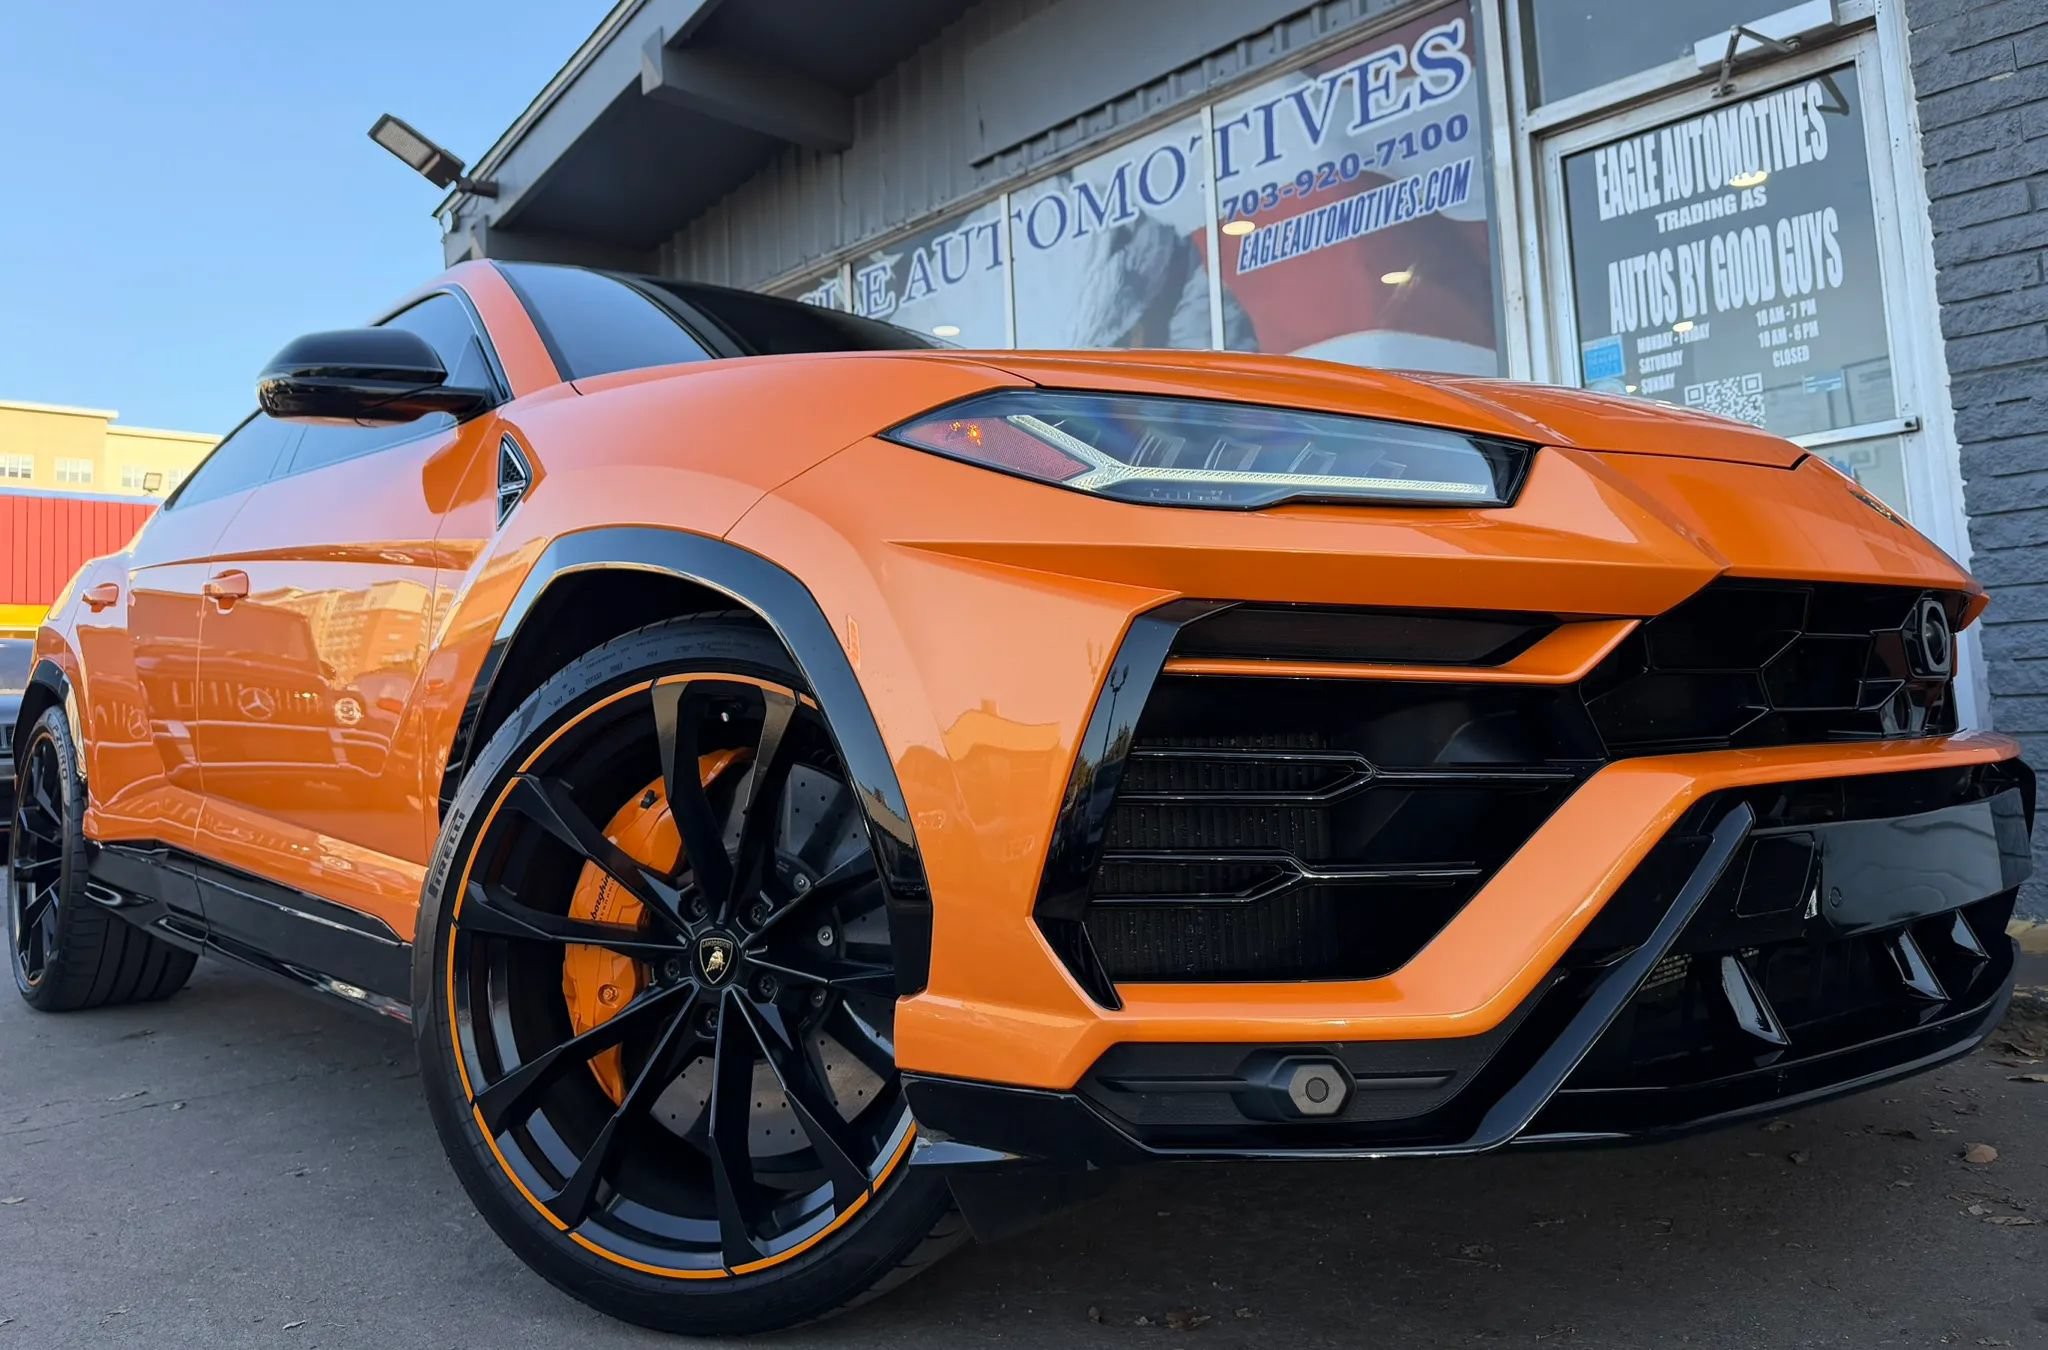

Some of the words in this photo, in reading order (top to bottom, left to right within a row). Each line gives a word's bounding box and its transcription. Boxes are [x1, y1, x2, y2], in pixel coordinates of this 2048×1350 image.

[900, 19, 1471, 305] AUTOMOTIVES
[1223, 114, 1469, 219] 703-920-7100
[1595, 136, 1661, 221] EAGLE
[1660, 82, 1829, 201] AUTOMOTIVES
[1238, 159, 1472, 275] EAGLEAUTOMOTIVES.COM
[1656, 191, 1737, 233] TRADING
[1741, 185, 1768, 211] AS
[1608, 248, 1677, 334] AUTOS
[1677, 240, 1710, 319] BY
[1710, 225, 1776, 312] GOOD
[1777, 207, 1843, 297] GUYS
[1769, 305, 1785, 324] AM
[1790, 302, 1798, 320] 7
[1800, 298, 1817, 317] PM
[1771, 327, 1788, 346] AM
[1802, 320, 1819, 339] PM
[1639, 350, 1683, 374] SATURDAY
[1772, 345, 1810, 368] CLOSED
[1641, 372, 1676, 395] SUNDAY
